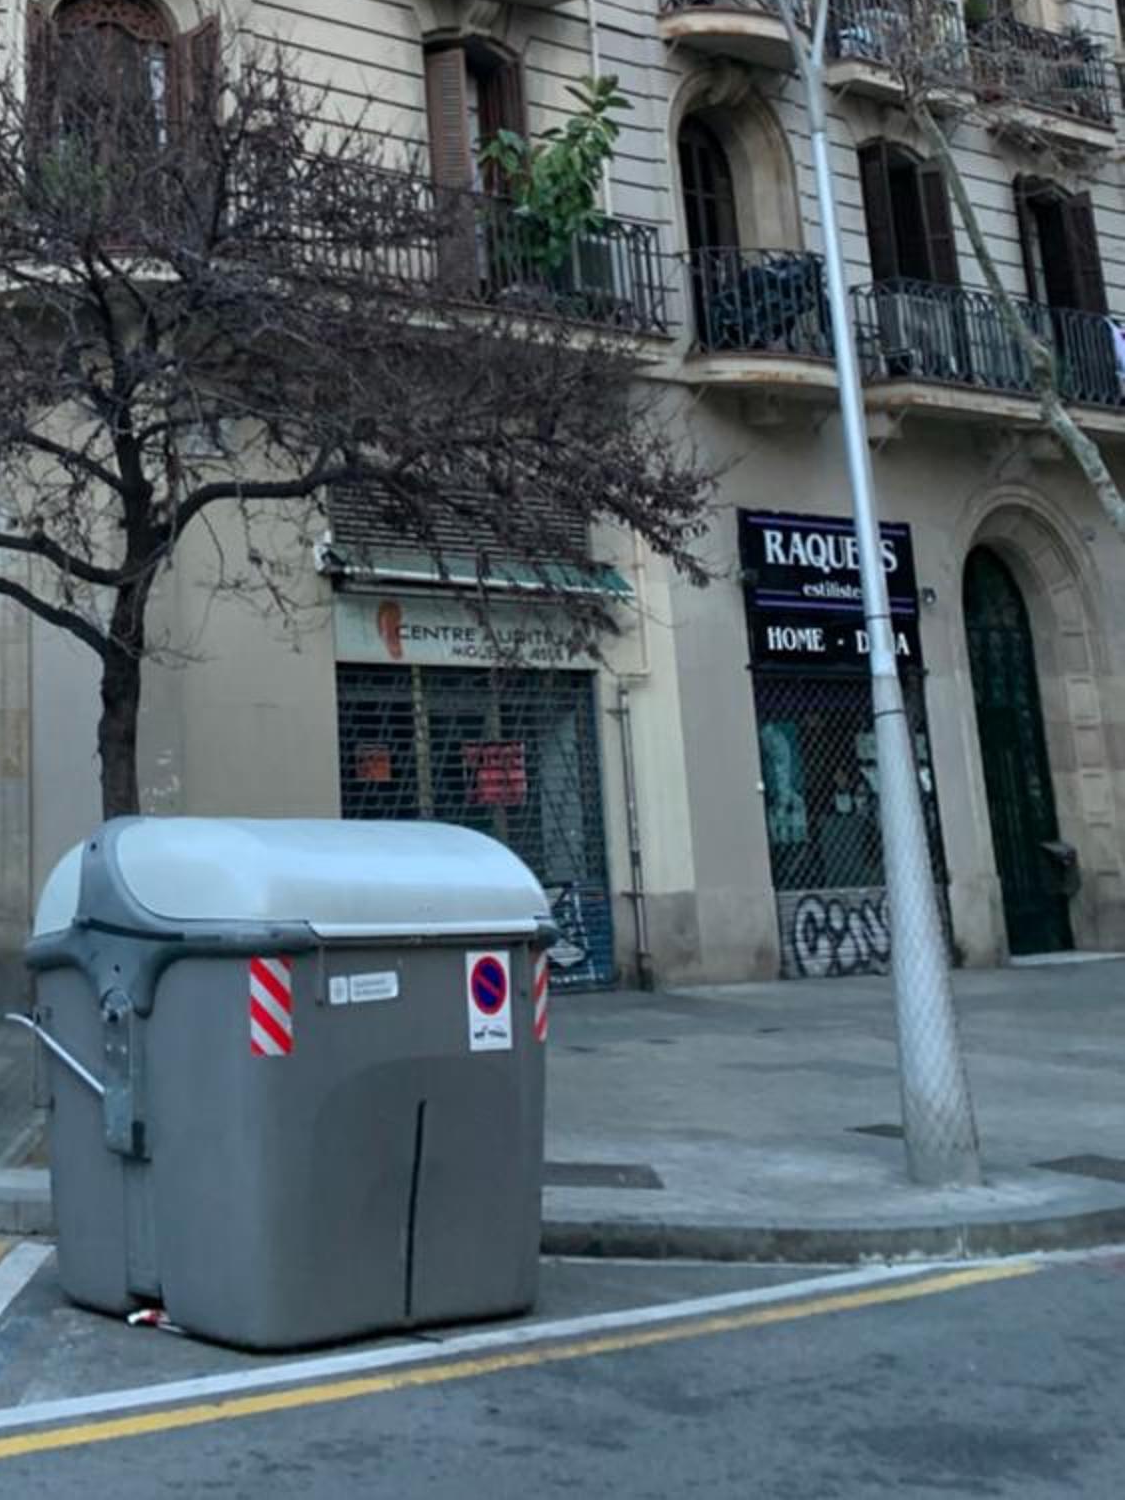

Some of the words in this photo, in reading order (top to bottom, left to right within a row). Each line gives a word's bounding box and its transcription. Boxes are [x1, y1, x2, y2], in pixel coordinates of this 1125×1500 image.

[763, 529, 898, 574] RAQUES
[802, 580, 863, 599] estiliste
[397, 623, 476, 643] CENTRE
[766, 625, 825, 652] HOME
[854, 629, 911, 656] DA
